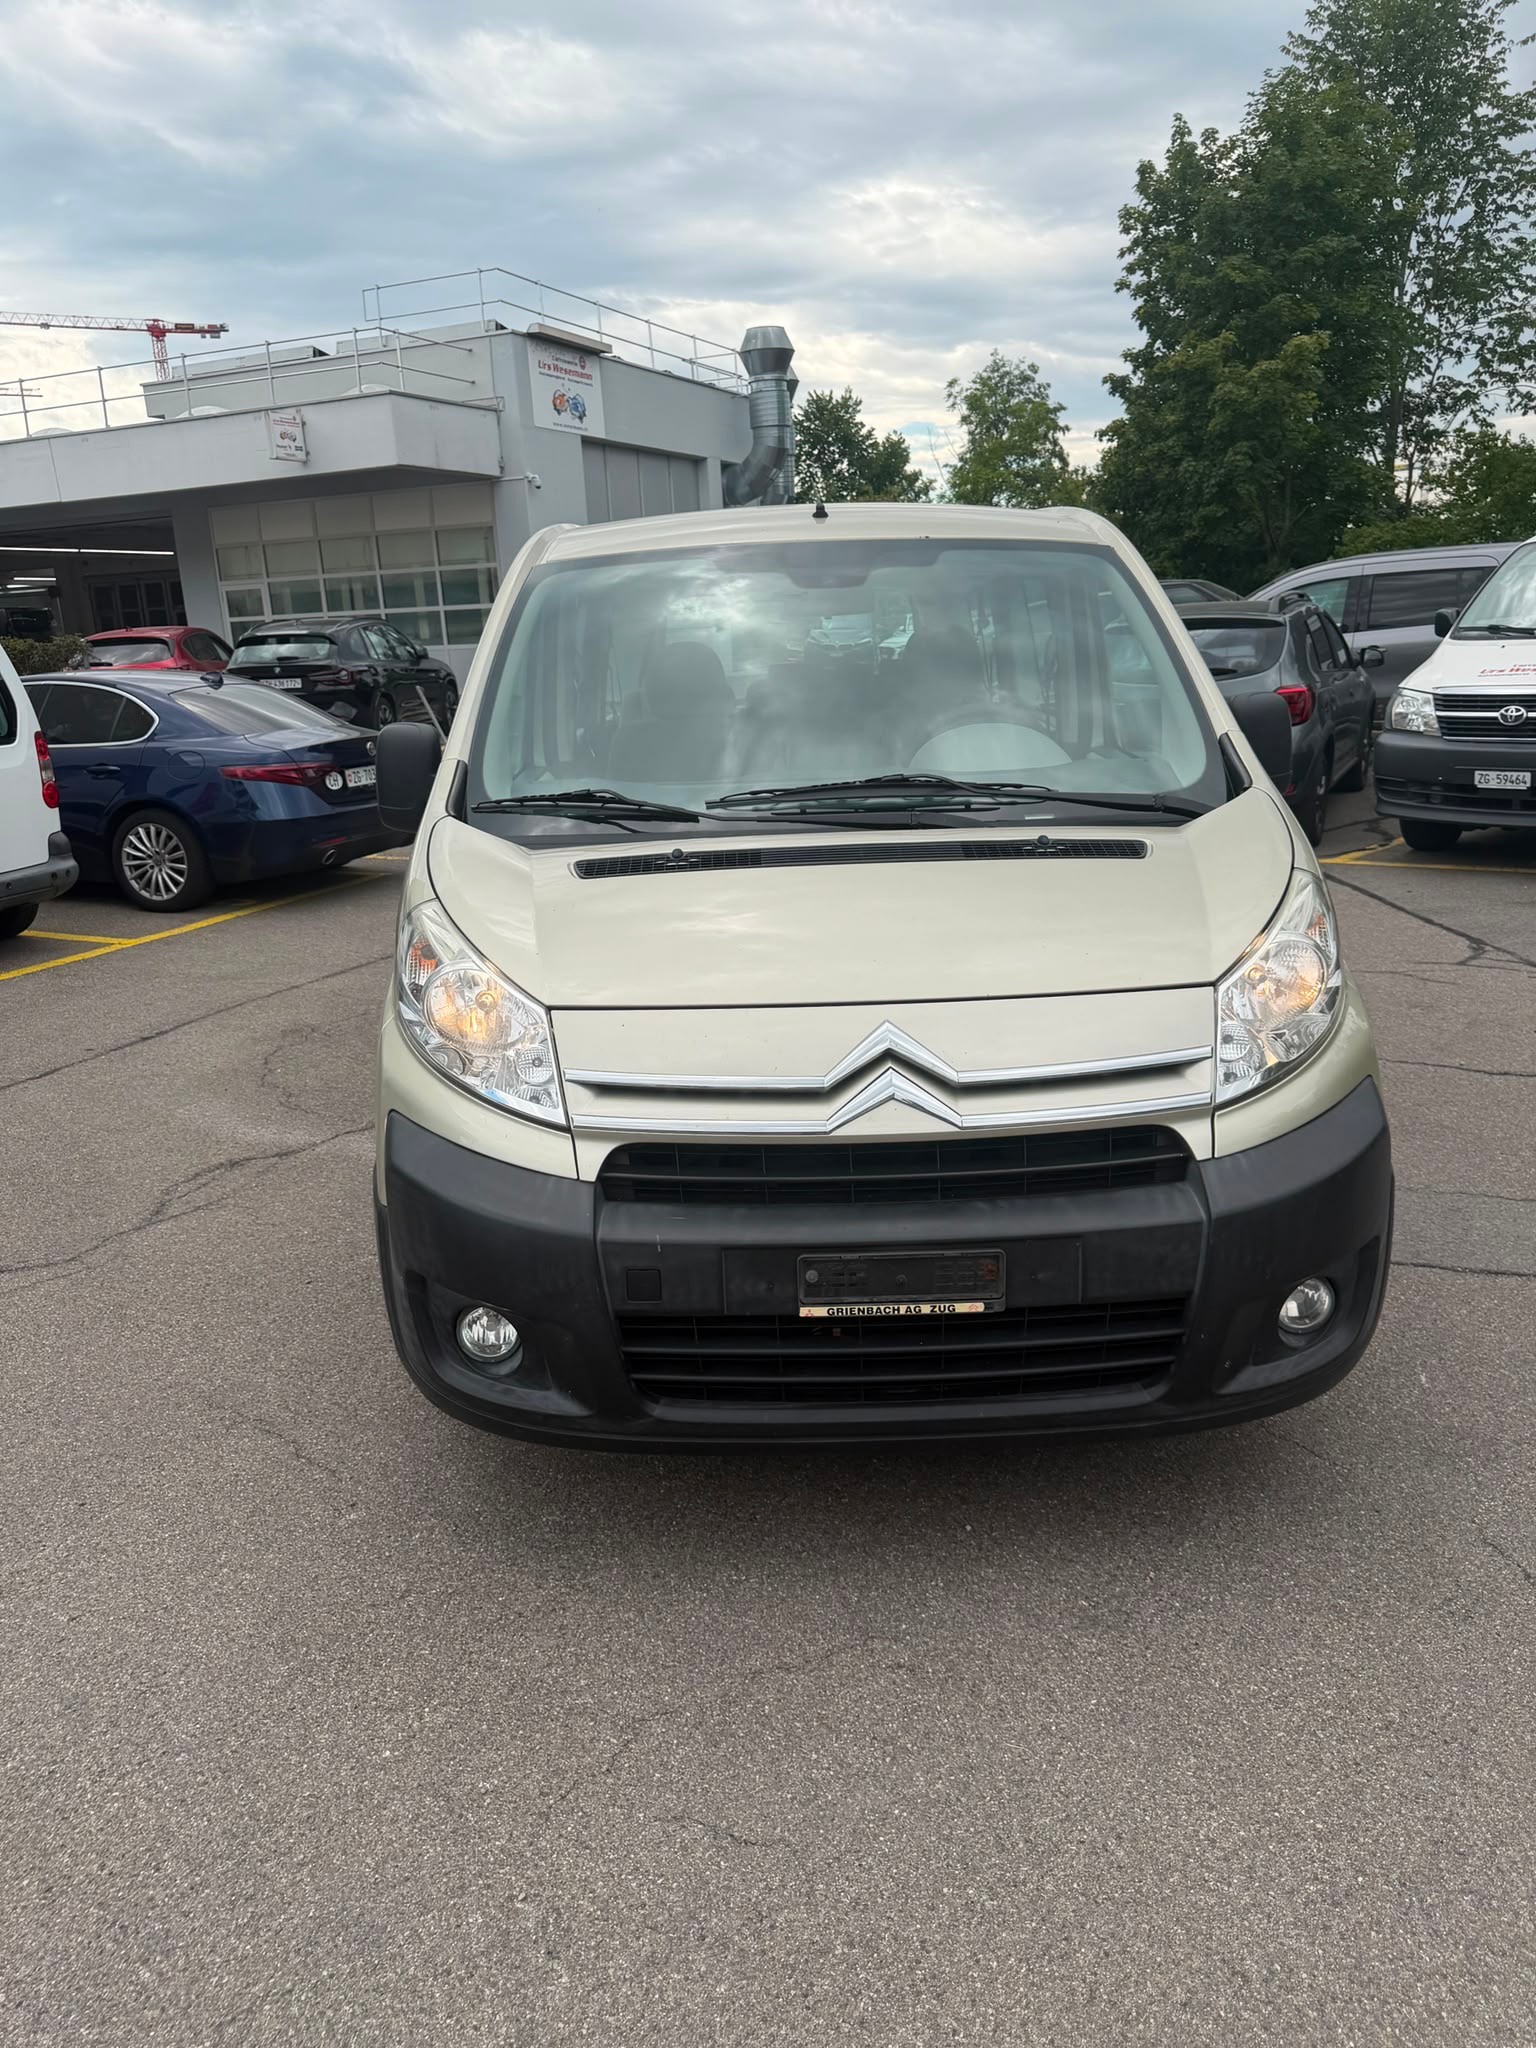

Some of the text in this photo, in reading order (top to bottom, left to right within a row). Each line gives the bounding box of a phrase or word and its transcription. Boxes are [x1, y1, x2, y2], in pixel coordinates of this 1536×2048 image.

[538, 360, 552, 370] Urs
[552, 363, 593, 381] Wesemann
[328, 774, 340, 788] CH
[827, 1304, 956, 1316] GRIENBACH AG ZUG
